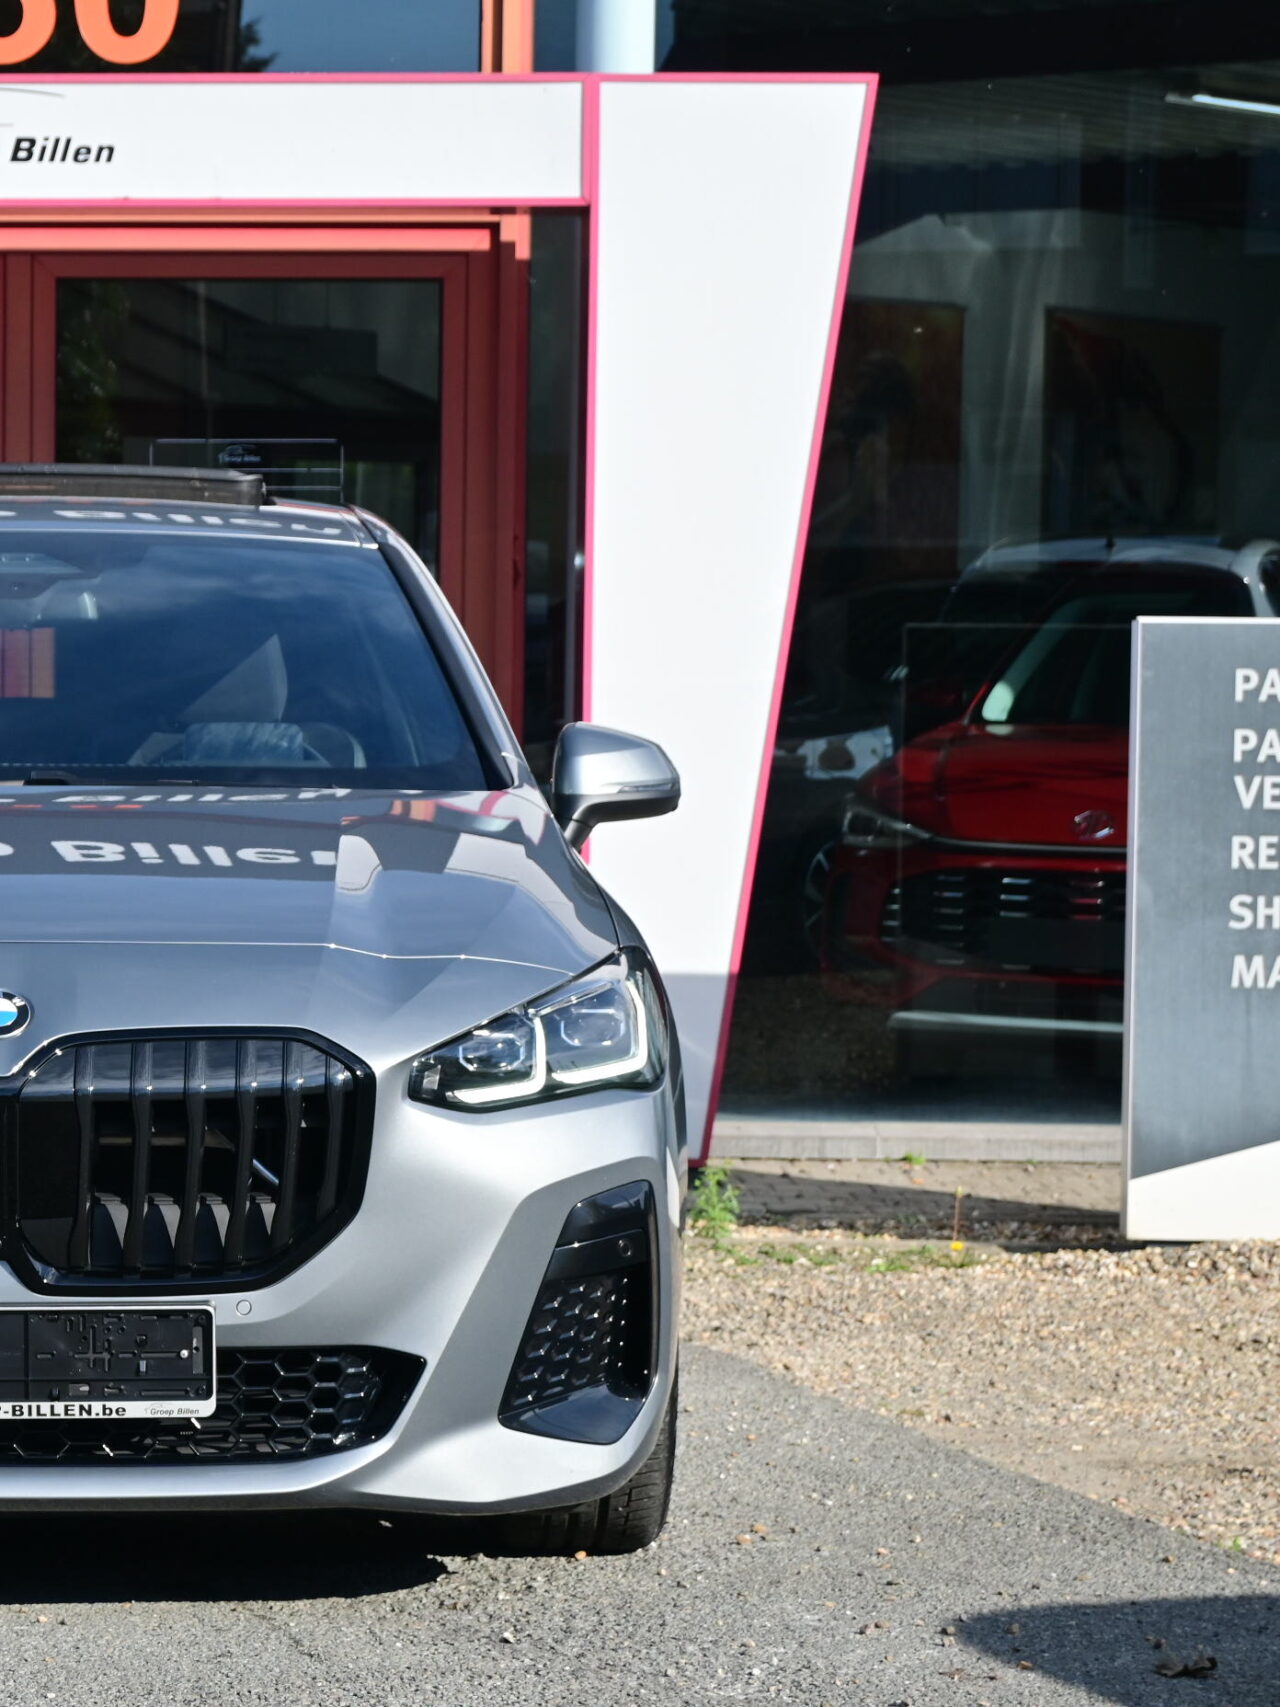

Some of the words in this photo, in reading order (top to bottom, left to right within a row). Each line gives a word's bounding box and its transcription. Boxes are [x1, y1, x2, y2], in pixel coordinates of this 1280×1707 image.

[10, 137, 115, 163] Billen
[1234, 667, 1280, 703] PA
[1233, 728, 1280, 763] PA
[1233, 775, 1280, 810] VE
[1230, 835, 1280, 870] RE
[1228, 894, 1280, 930] SH
[150, 1408, 175, 1417] Groep
[176, 1407, 200, 1416] Billen
